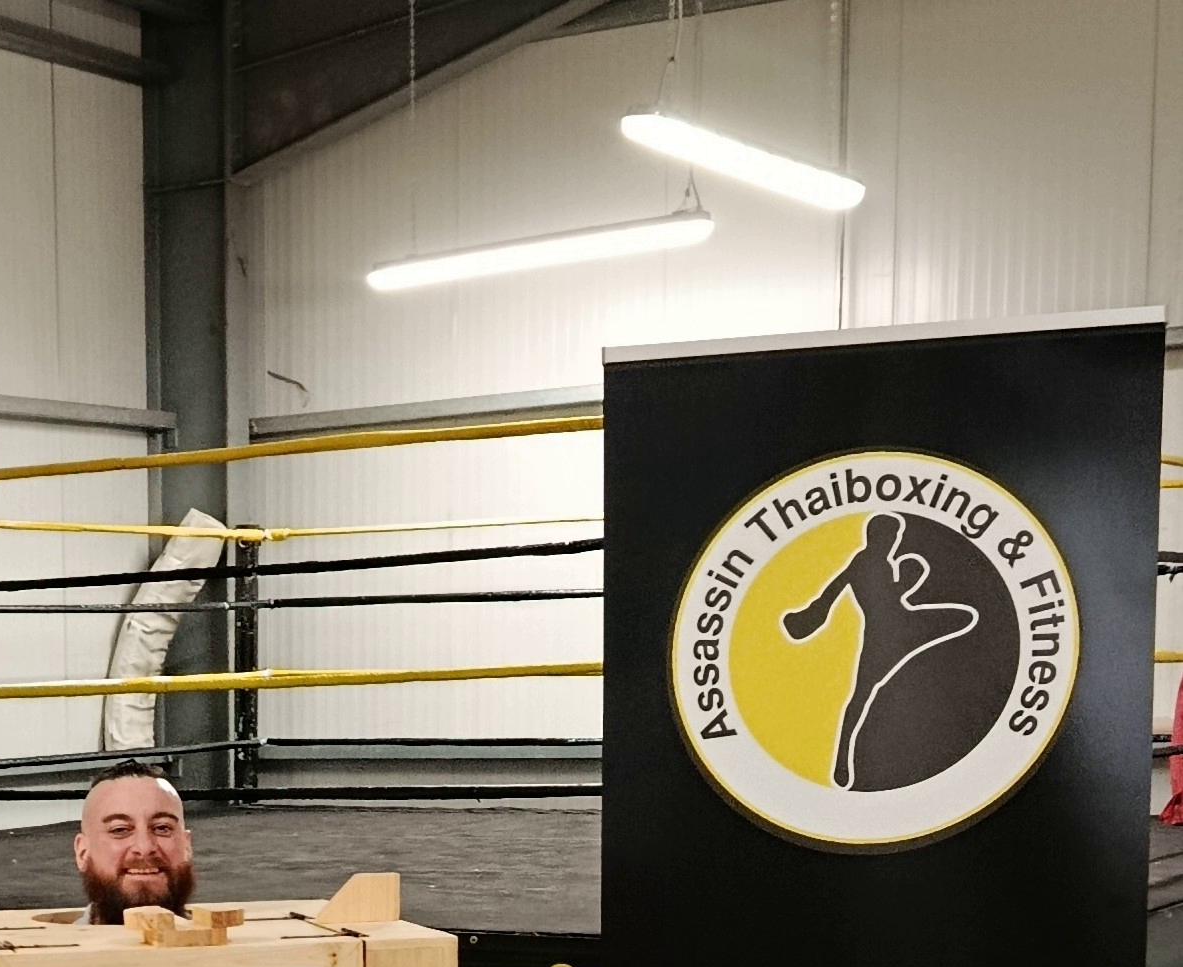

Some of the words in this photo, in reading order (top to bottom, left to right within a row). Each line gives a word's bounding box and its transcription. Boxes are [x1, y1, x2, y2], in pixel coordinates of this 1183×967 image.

[742, 467, 1000, 542] Thaiboxing
[997, 528, 1035, 569] &
[692, 548, 756, 741] Assassin
[1008, 568, 1066, 737] Fitness
